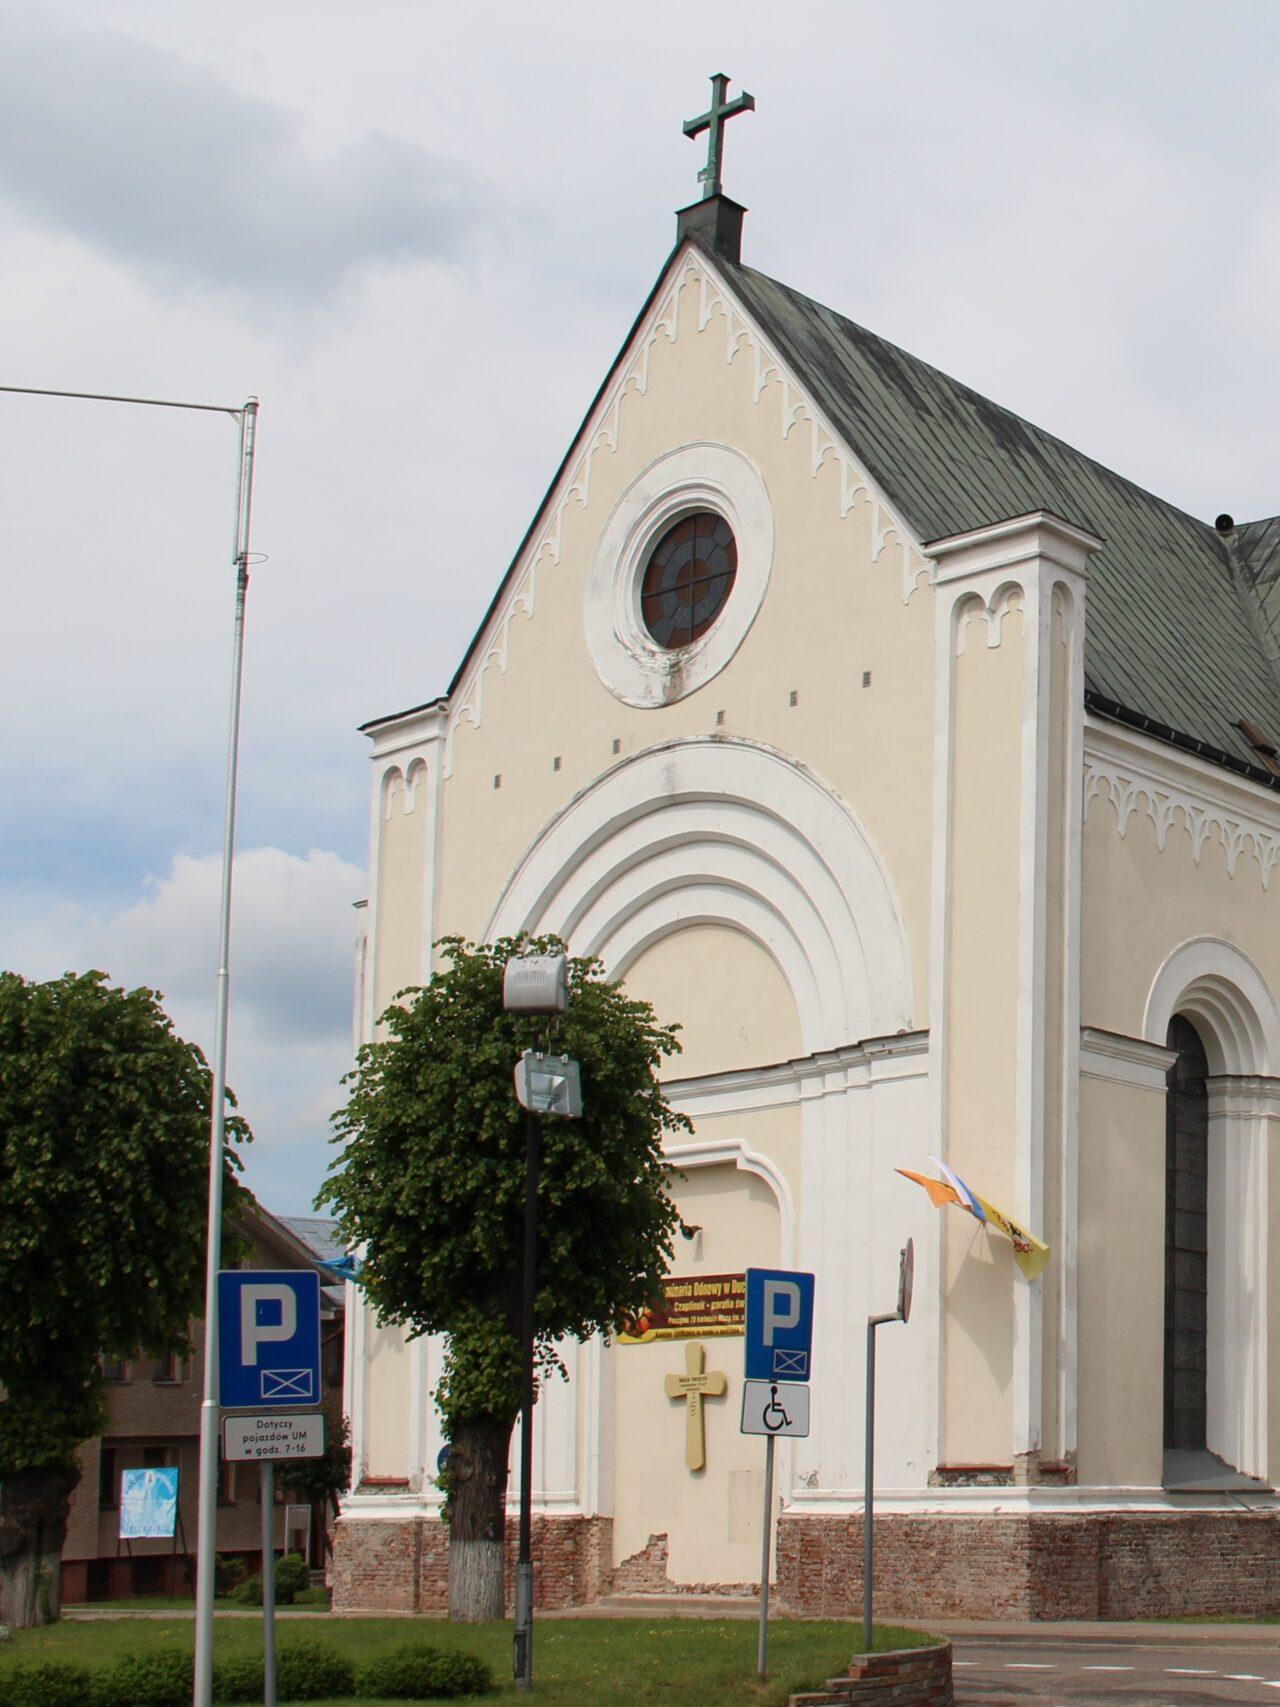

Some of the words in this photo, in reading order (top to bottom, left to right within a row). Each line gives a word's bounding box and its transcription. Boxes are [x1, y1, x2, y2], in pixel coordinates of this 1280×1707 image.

[694, 1281, 722, 1296] Odnowy
[724, 1282, 731, 1294] w
[732, 1280, 746, 1294] Duc
[763, 1280, 801, 1346] P
[240, 1283, 297, 1366] P
[257, 1420, 293, 1431] Dotyczy
[243, 1432, 289, 1444] pojazdów
[292, 1431, 307, 1440] UM
[245, 1447, 253, 1455] w
[256, 1445, 282, 1457] godz.
[285, 1443, 306, 1454] 7-16
